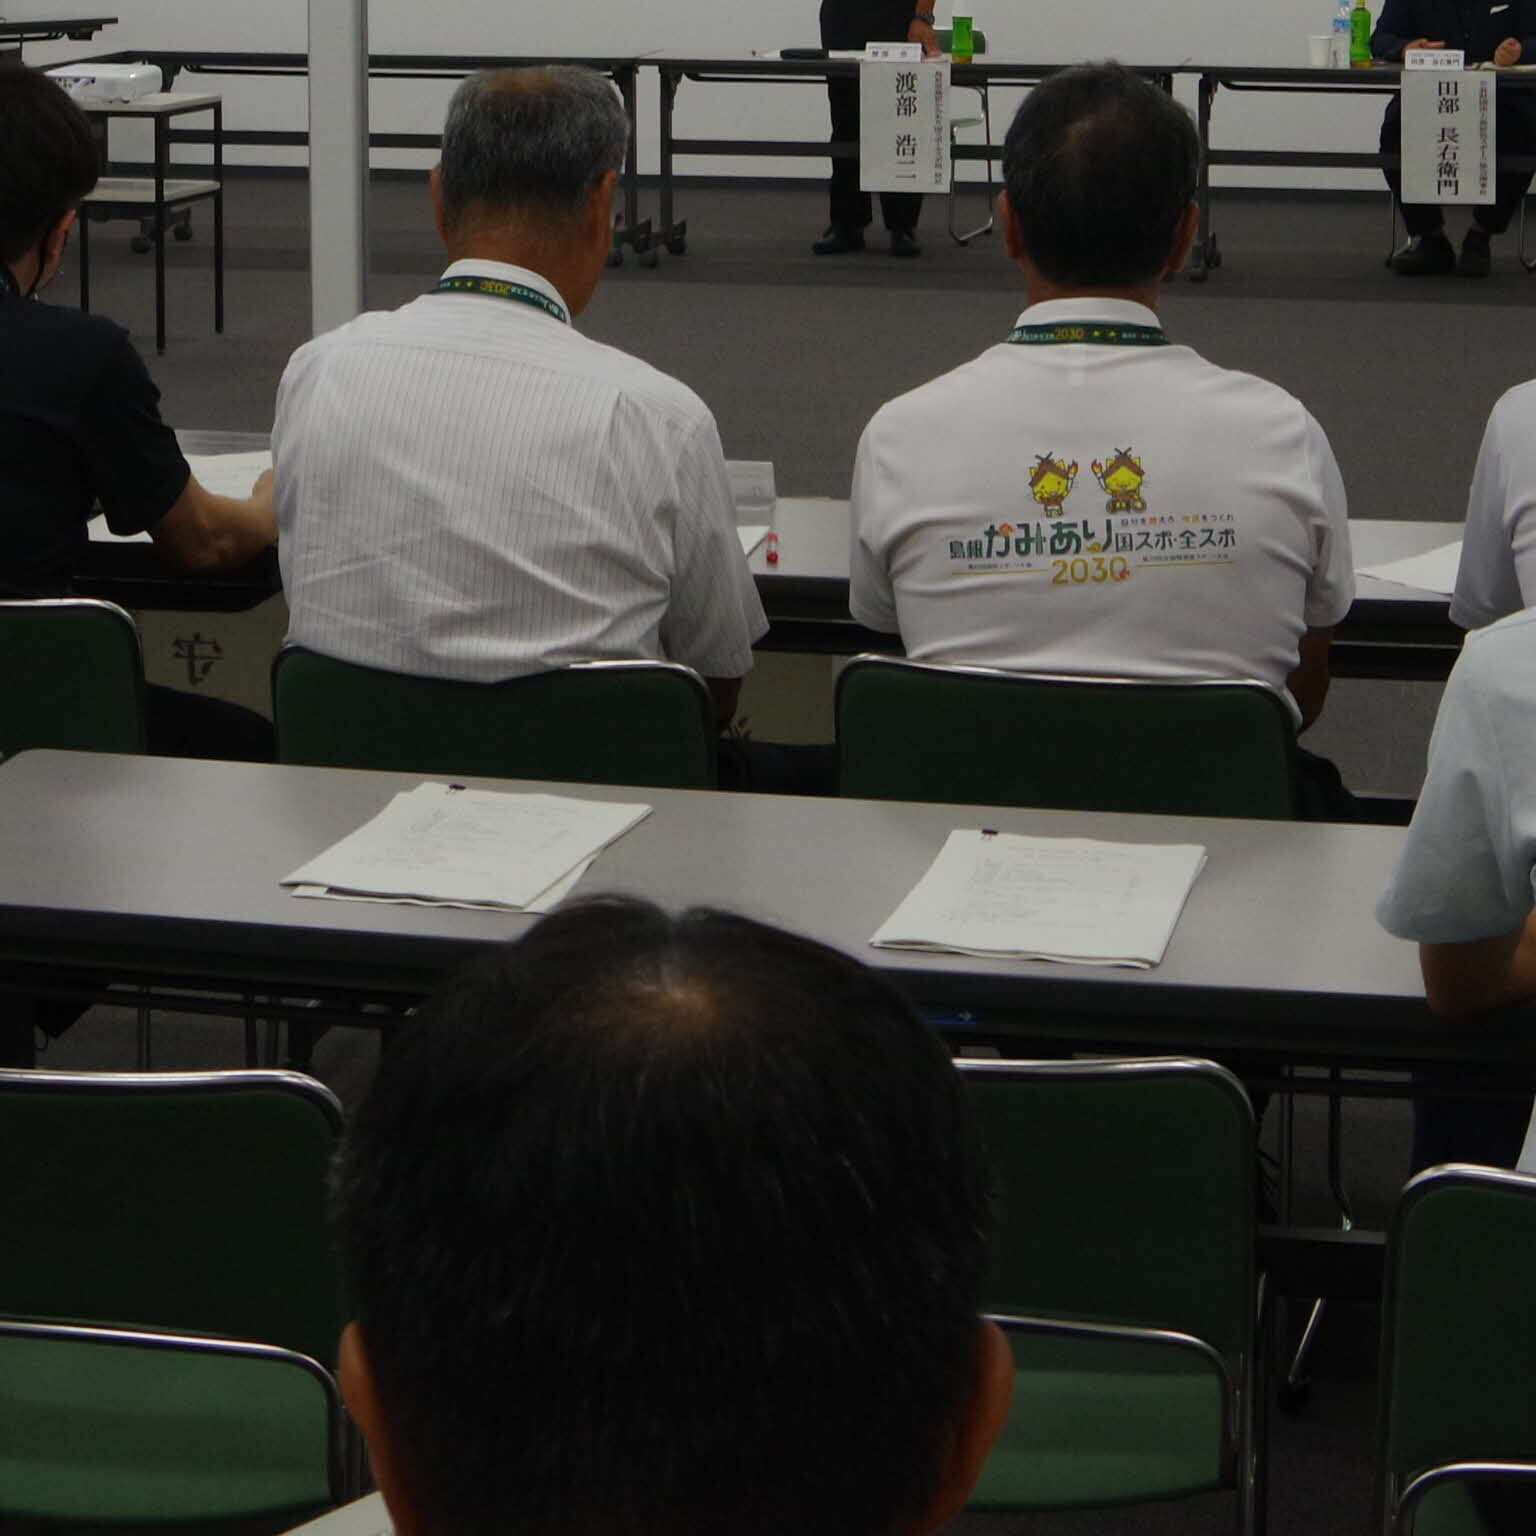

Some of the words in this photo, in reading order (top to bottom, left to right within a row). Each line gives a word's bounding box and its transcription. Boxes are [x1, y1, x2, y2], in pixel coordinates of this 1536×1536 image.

[895, 71, 917, 117] 渡部
[1438, 80, 1460, 114] 田部
[1052, 557, 1130, 584] 2030
